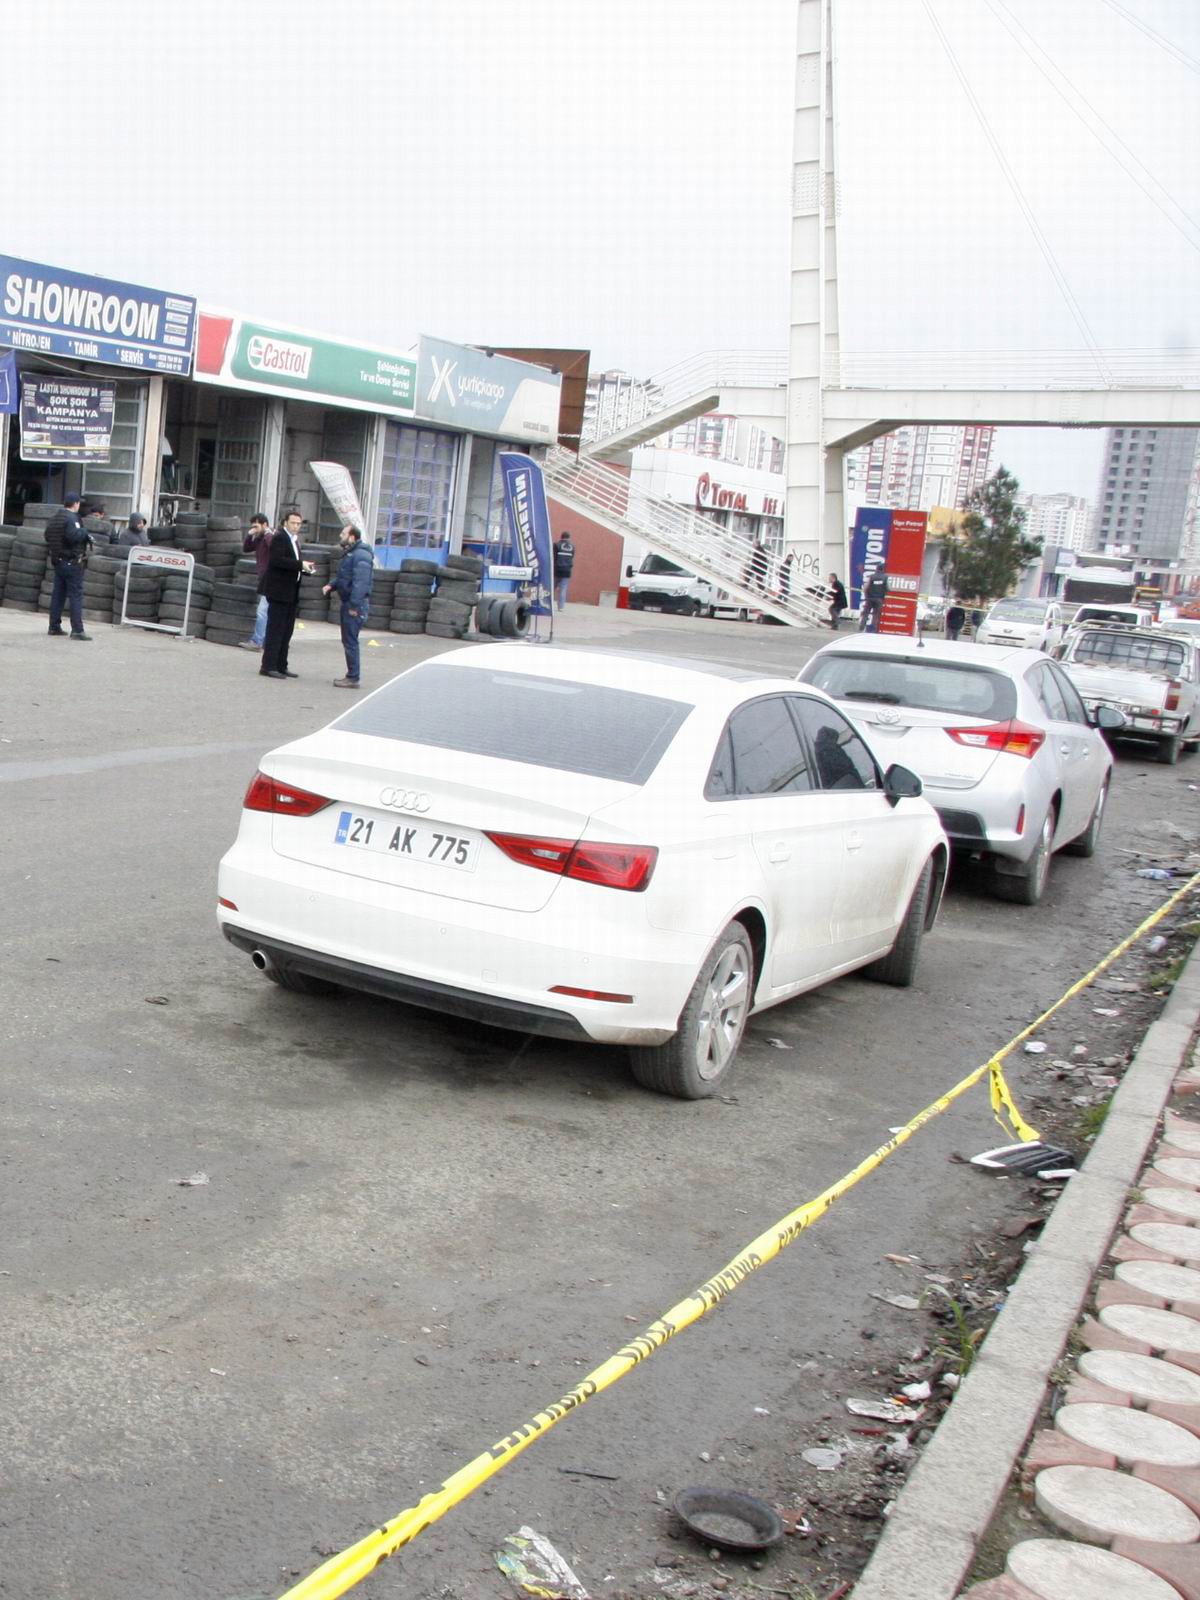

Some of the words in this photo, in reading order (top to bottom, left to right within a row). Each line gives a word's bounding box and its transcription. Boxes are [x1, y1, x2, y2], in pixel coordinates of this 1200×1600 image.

[3, 274, 160, 341] SHOWROOM
[74, 340, 99, 358] TAMİR
[120, 349, 144, 365] SERVİS
[263, 343, 307, 374] Castrol
[36, 405, 99, 418] KAMPANYA
[711, 483, 749, 511] TOTAL
[350, 817, 375, 844] 21
[388, 825, 418, 854] AK
[427, 833, 471, 865] 775
